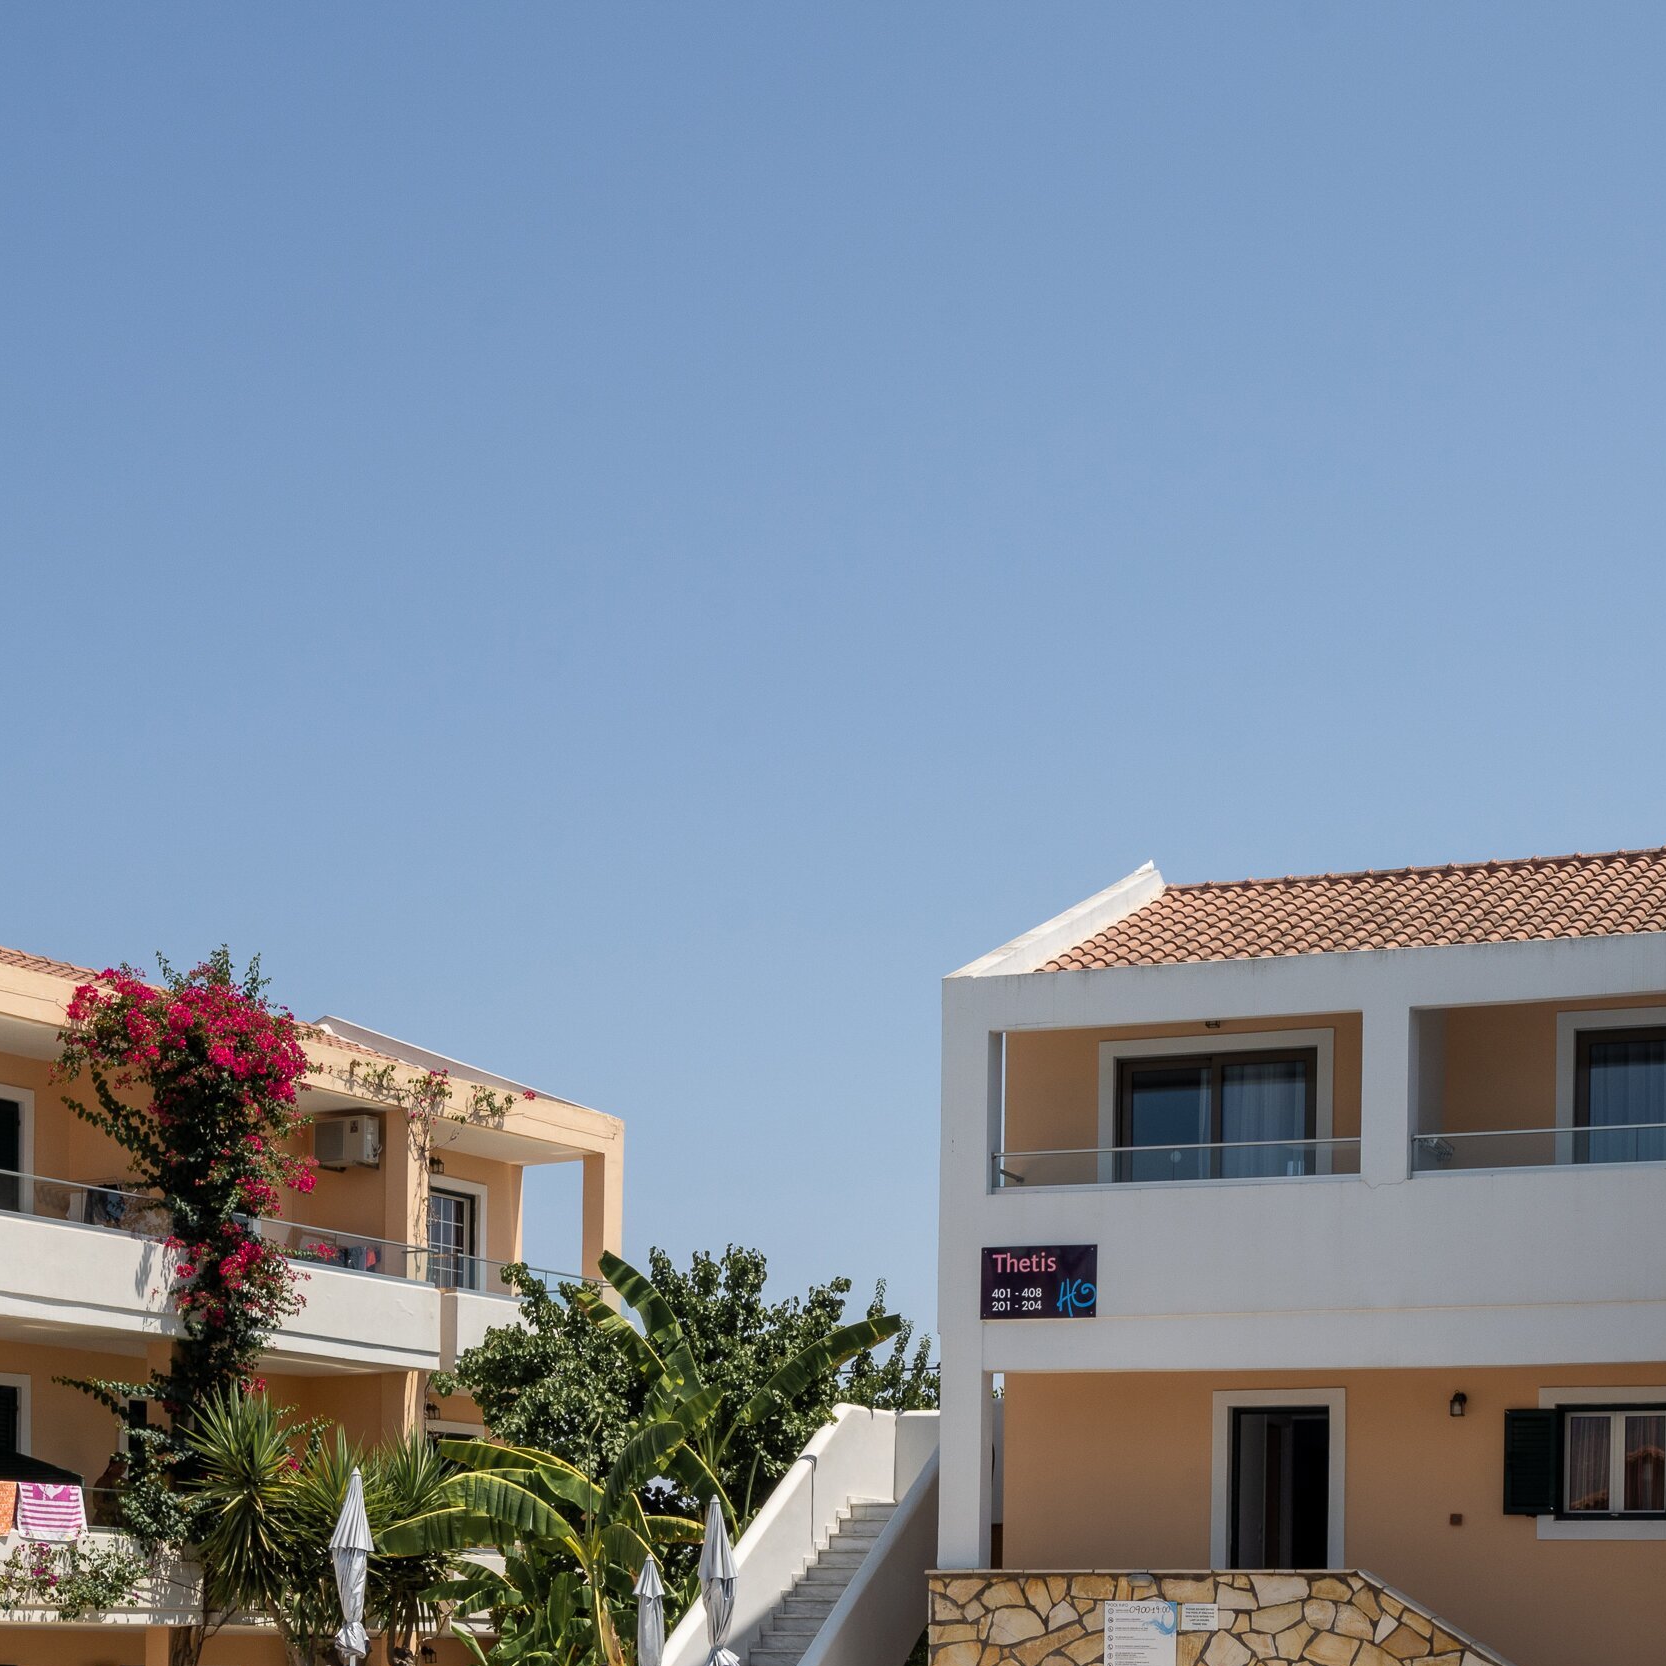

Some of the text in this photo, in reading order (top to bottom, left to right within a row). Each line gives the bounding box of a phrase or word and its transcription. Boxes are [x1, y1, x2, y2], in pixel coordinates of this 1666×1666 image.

[992, 1252, 1057, 1273] Thetis
[992, 1288, 1011, 1299] 401
[1021, 1287, 1042, 1298] 408
[992, 1301, 1011, 1311] 201
[1021, 1300, 1042, 1311] 204
